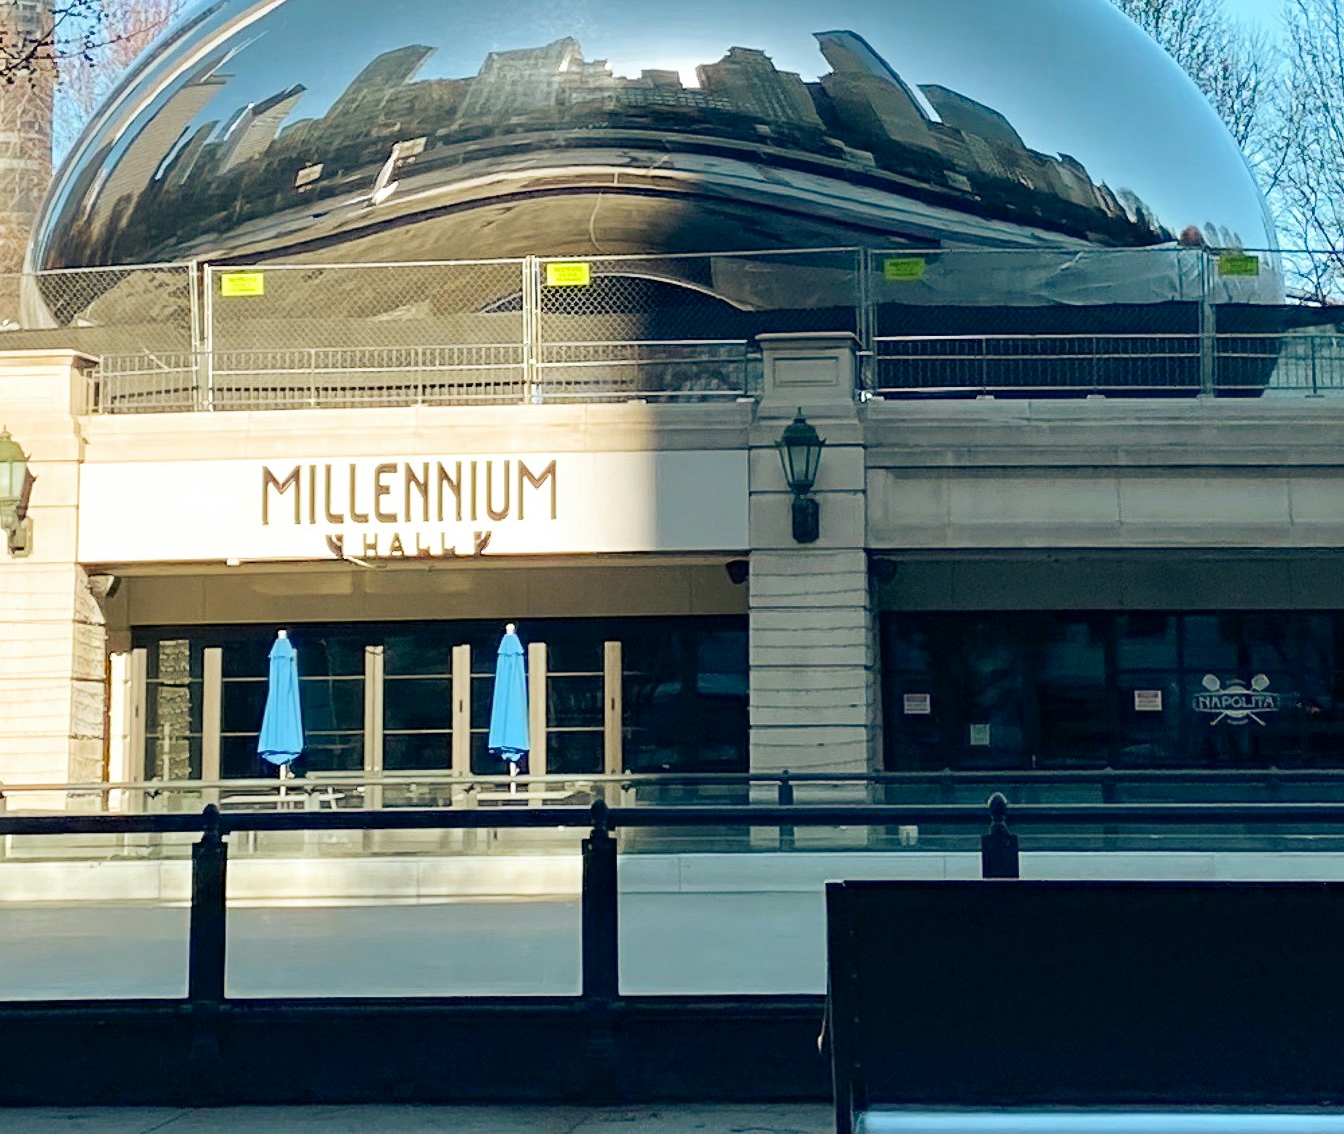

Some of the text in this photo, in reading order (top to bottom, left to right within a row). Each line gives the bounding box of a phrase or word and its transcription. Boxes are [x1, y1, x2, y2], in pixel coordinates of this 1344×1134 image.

[261, 459, 557, 526] MILLENNIUM
[363, 531, 457, 558] HALL
[1199, 696, 1274, 709] NAPOLITA
